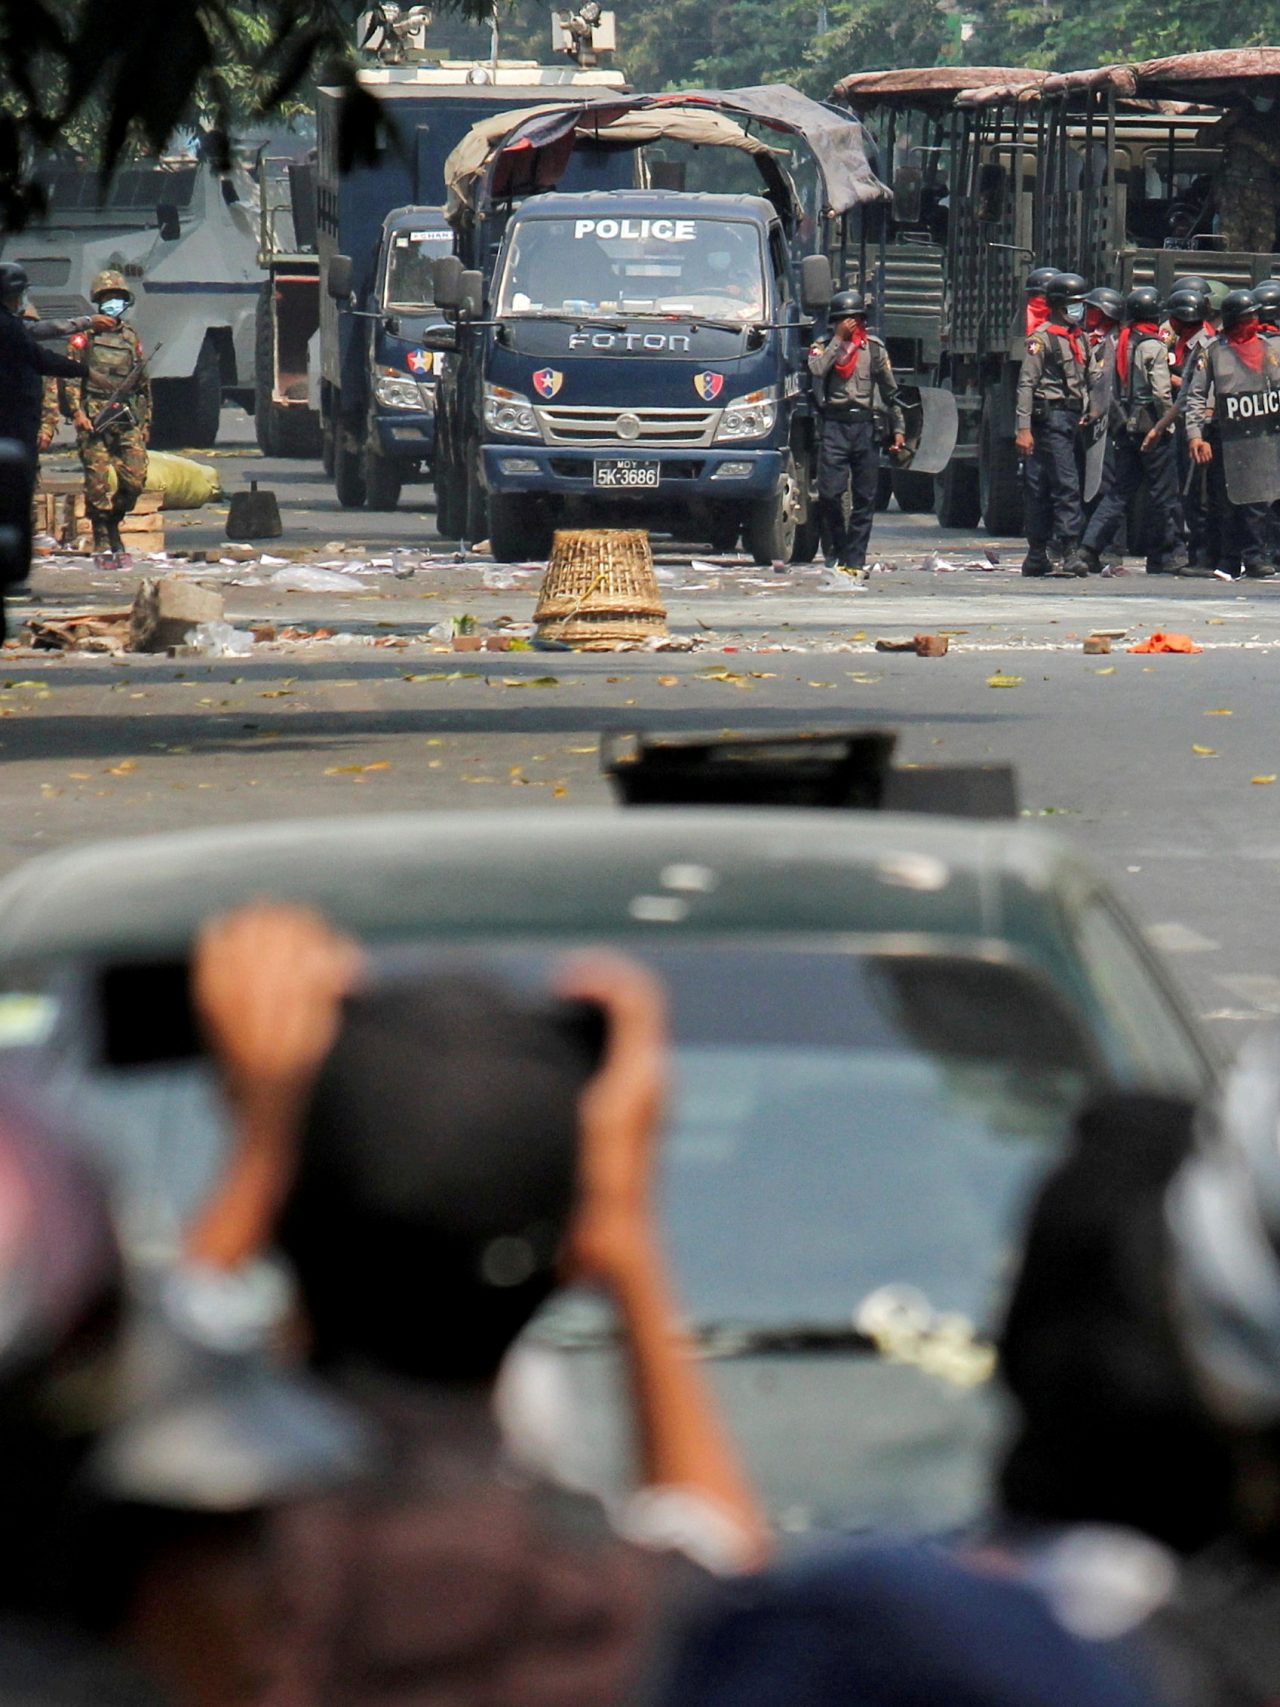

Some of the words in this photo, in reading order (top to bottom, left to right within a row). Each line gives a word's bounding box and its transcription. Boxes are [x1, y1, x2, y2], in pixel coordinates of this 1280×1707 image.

[574, 219, 697, 240] POLICE
[568, 333, 690, 352] FOTON
[598, 468, 656, 485] 5K-3686
